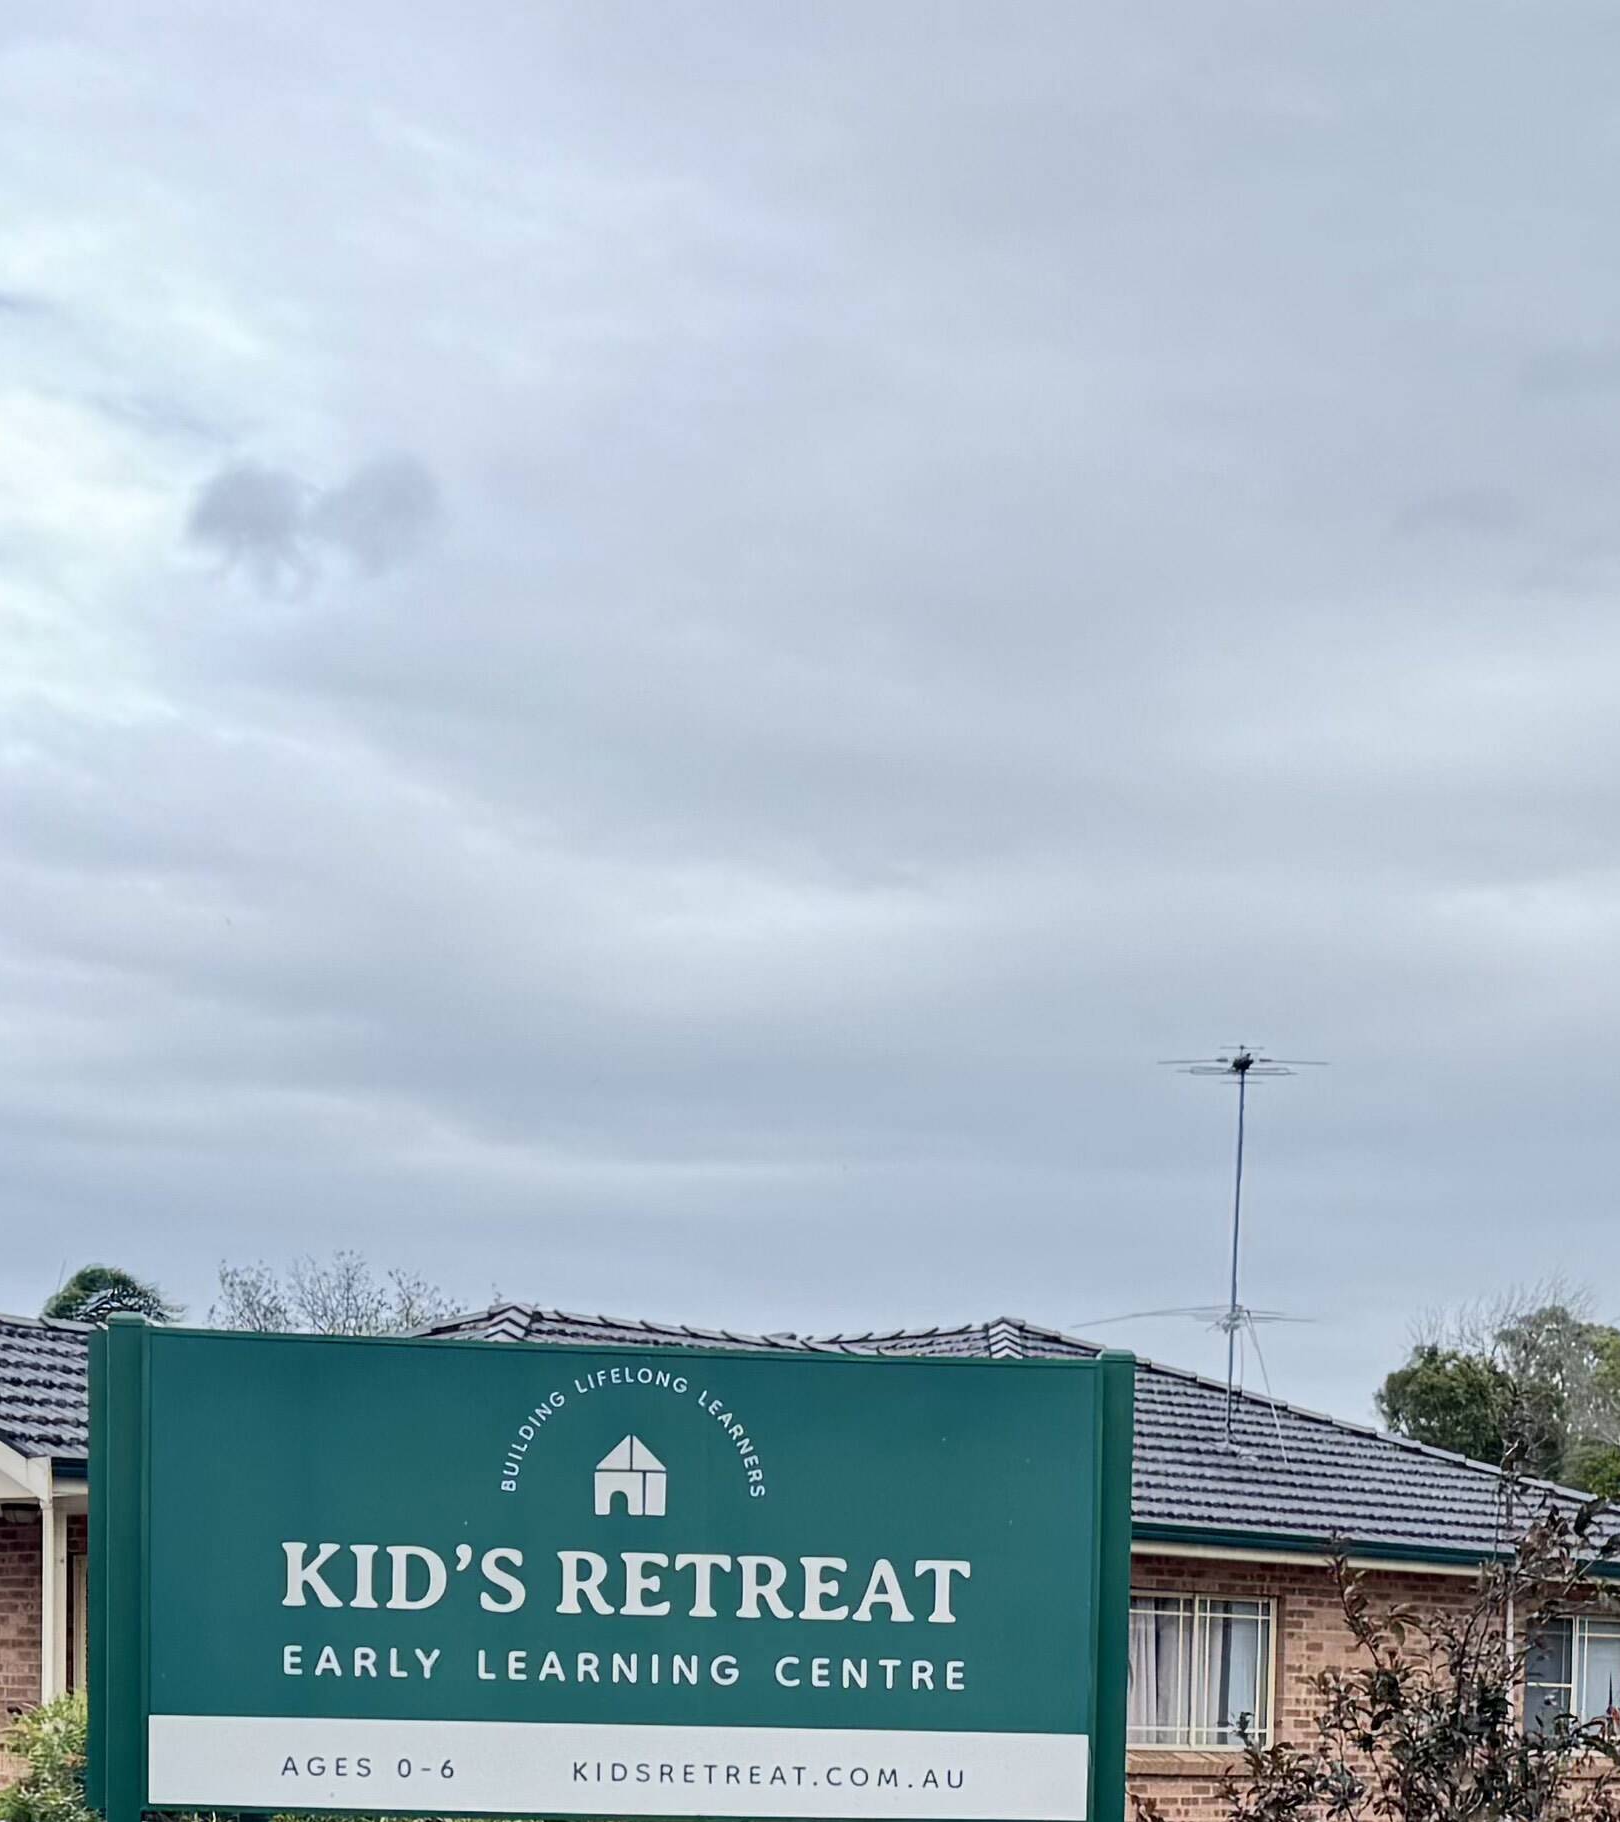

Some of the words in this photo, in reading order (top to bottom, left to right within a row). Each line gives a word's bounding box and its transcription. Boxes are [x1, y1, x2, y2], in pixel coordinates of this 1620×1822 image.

[500, 1390, 566, 1493] BUILDING
[574, 1367, 689, 1394] LIFELONG
[697, 1390, 766, 1498] LEARNERS
[281, 1541, 527, 1613] KID'S
[556, 1550, 971, 1624] RETREAT
[282, 1644, 442, 1679] EARLY
[477, 1649, 741, 1686] LEARNING
[774, 1656, 966, 1691] CENTRE
[281, 1755, 374, 1778] AGES
[397, 1758, 456, 1780] 0-6
[572, 1760, 966, 1790] KIDSRETREAT.COM.AU
